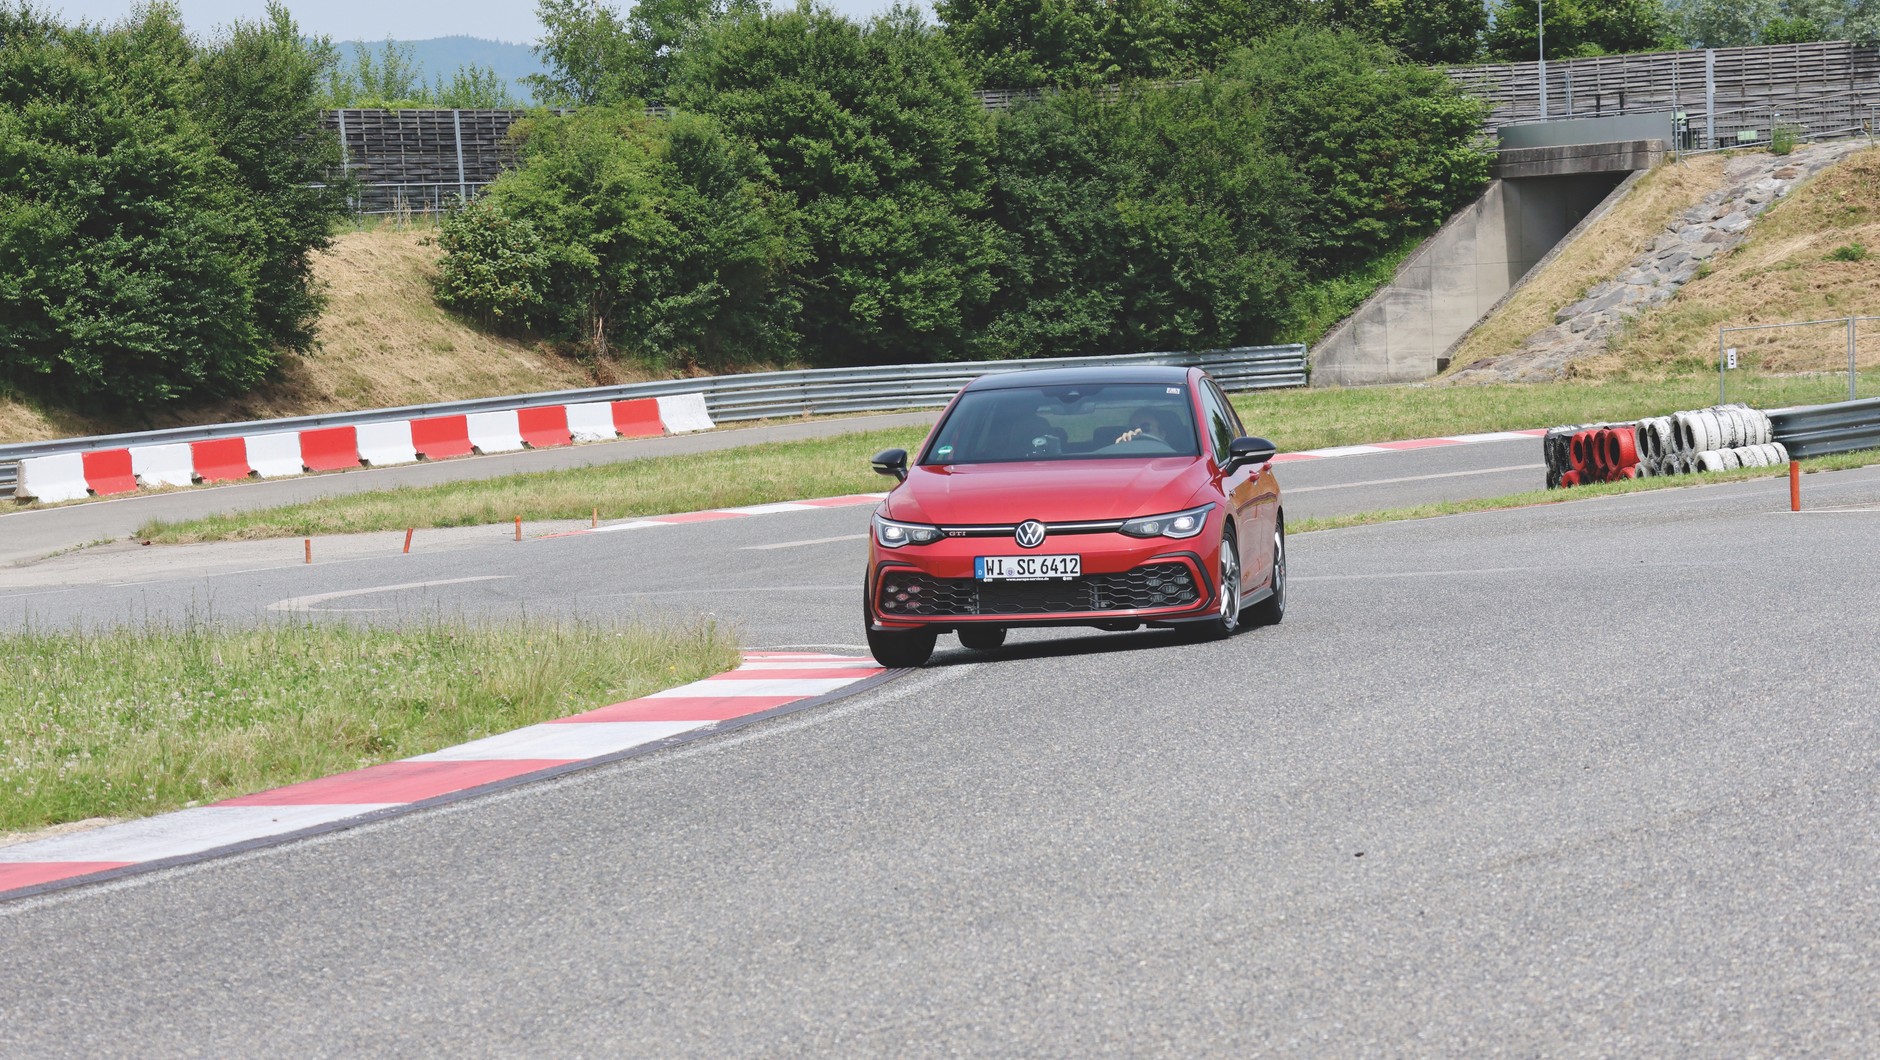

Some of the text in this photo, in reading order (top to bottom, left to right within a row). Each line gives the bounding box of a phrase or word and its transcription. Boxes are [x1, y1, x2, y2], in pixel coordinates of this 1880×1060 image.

[985, 557, 1079, 576] WI SC 6412
